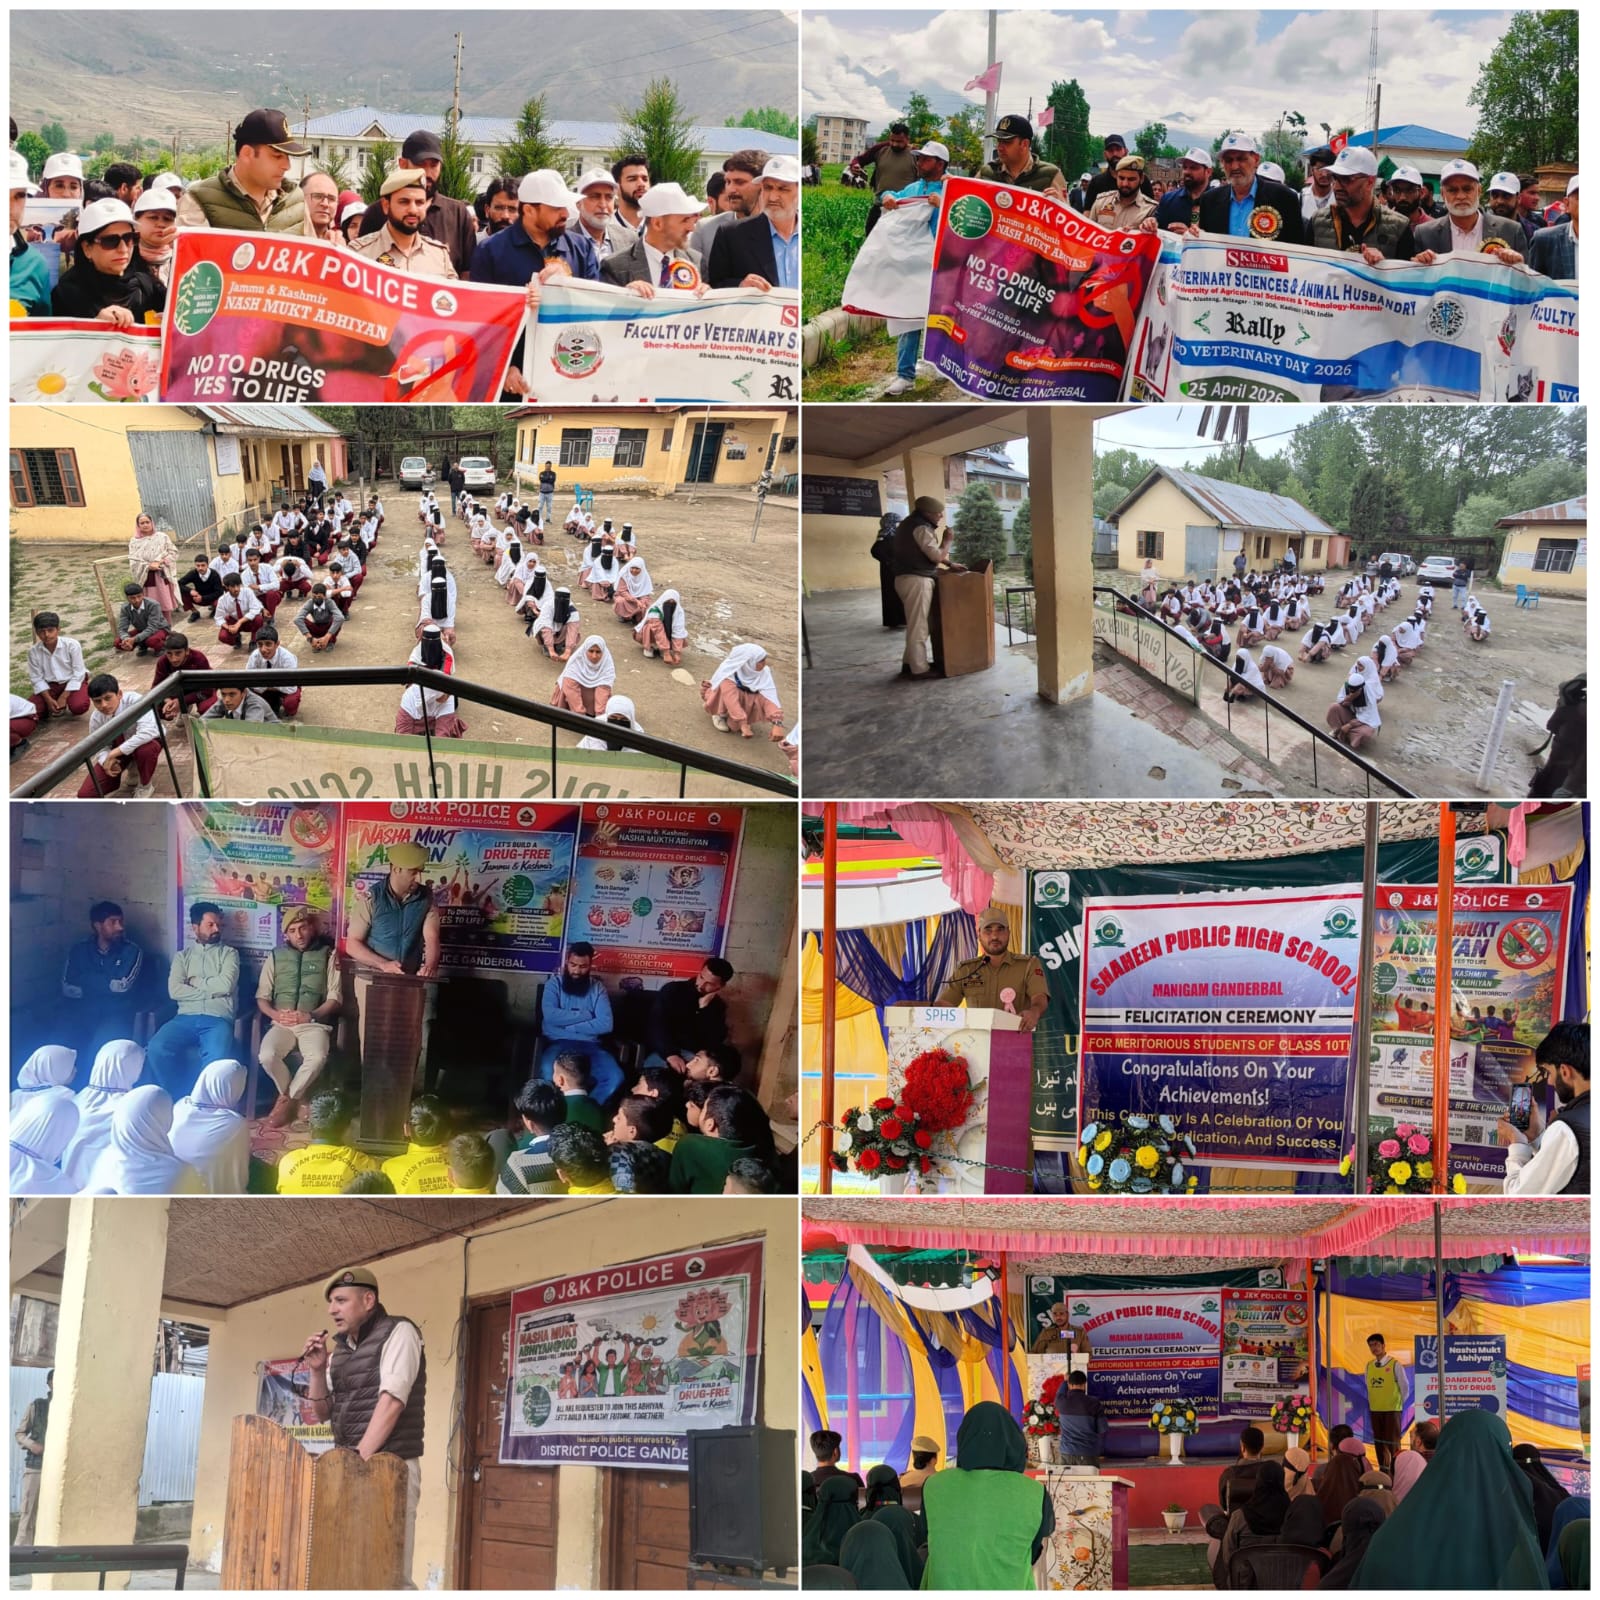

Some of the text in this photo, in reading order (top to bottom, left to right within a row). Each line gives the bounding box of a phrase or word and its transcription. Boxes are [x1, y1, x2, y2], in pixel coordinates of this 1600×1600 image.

[1016, 197, 1050, 223] J&K
[1055, 212, 1114, 250] POLICE
[996, 224, 1022, 241] NASH
[1227, 250, 1287, 268] SKUAST
[257, 246, 418, 309] J&K POLICE
[966, 253, 1056, 303] NO TO DRUGS
[228, 281, 328, 305] Jammu & Kashmir
[969, 271, 1044, 314] YES TO LIFE
[1235, 271, 1289, 295] SCIENCES
[1290, 278, 1298, 295] &
[1299, 280, 1340, 300] ANIMAL
[1343, 283, 1417, 316] HUSBANDRY
[223, 296, 262, 311] NASH
[263, 298, 312, 320] MUKT
[313, 308, 388, 340] ABHIYAN
[623, 323, 681, 339] FACULTY
[684, 325, 701, 341] OF
[704, 323, 785, 347] VETERINARY
[1225, 311, 1286, 345] Rally
[1192, 345, 1282, 366] VETERINARY
[1286, 356, 1310, 375] DAY
[1314, 363, 1352, 376] 2026
[187, 354, 326, 388] NO TO DRUGS
[940, 354, 1087, 398] DISTRICT POLICE GANDERBAL
[193, 376, 226, 396] YES
[232, 377, 260, 398] TO
[1187, 382, 1285, 402] 25 April 2026
[410, 801, 511, 819] J&K POLICE
[617, 808, 696, 823] J&K POLICE
[358, 824, 463, 849] NASHA MUKT
[618, 834, 709, 846] NASHA MUKTH ABHIYAN
[483, 849, 551, 860] DRUG-FREE
[611, 850, 648, 858] DANGEROUS
[512, 862, 519, 870] &
[462, 955, 526, 968] GANDERBAL
[627, 960, 673, 968] ADDICTION
[1089, 925, 1357, 997] SHAHEEN PUBLIC HIGH SCHOOL
[1454, 970, 1488, 978] KASHMIR
[1152, 981, 1284, 997] MANIGAM GANDERBAL
[925, 1008, 956, 1021] SPHS
[1125, 1010, 1316, 1023] FELICITATION CEREMONY
[1088, 1037, 1112, 1049] FOR
[1115, 1038, 1190, 1050] MERITORIOUS
[1193, 1039, 1256, 1051] STUDENTS
[1259, 1039, 1275, 1051] OF
[1279, 1039, 1321, 1051] CLASS
[1122, 1058, 1315, 1081] Congratulations On Your
[1159, 1085, 1270, 1106] Achievements!
[1384, 1095, 1425, 1106] BREAK THE
[1089, 1109, 1116, 1120] This
[1186, 1112, 1197, 1124] Is
[1200, 1113, 1211, 1124] A
[1214, 1113, 1291, 1128] Celebration
[1295, 1117, 1312, 1129] Of
[1244, 1133, 1272, 1146] And
[1276, 1134, 1341, 1149] Success.
[558, 1262, 674, 1299] J&K POLICE
[1115, 1305, 1153, 1320] PUBLIC
[1155, 1306, 1182, 1320] HIGH
[1182, 1310, 1220, 1338] SCHOOL
[1234, 1311, 1281, 1320] ABHIYAN
[519, 1329, 550, 1345] NASHA
[551, 1323, 578, 1341] MUKT
[1094, 1346, 1202, 1355] FELICITATION CEREMONY
[1456, 1355, 1494, 1363] Abhiyan
[1088, 1361, 1134, 1369] MERITORIOUS
[1135, 1360, 1171, 1368] STUDENTS
[1093, 1371, 1203, 1385] Congratulations On Your
[679, 1387, 730, 1400] DRUG-FREE
[1117, 1384, 1180, 1395] Achievements!
[575, 1403, 604, 1411] REQUESTED
[608, 1436, 631, 1444] public
[541, 1446, 586, 1457] DISTRICT
[590, 1445, 636, 1458] POLICE
